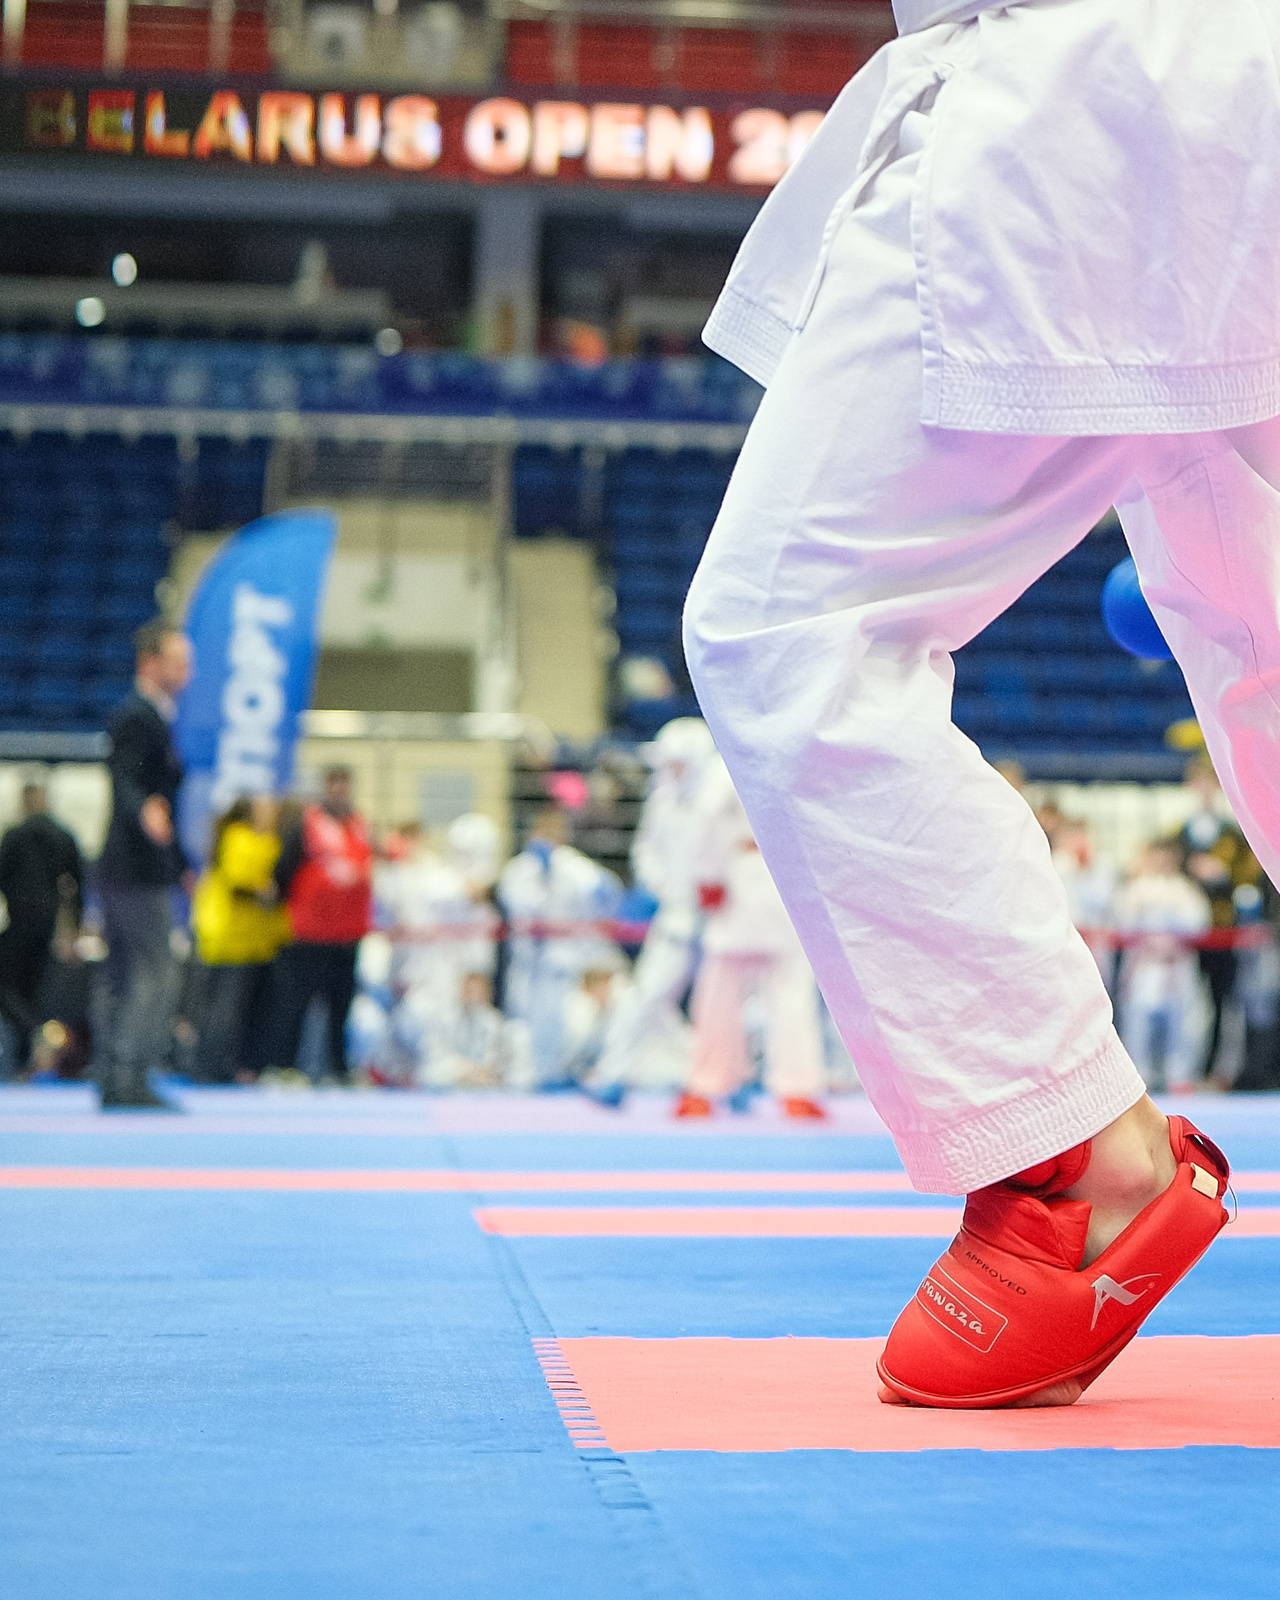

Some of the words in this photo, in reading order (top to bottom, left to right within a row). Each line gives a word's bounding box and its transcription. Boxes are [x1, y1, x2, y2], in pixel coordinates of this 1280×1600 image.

[26, 89, 443, 169] BELARUS
[464, 97, 714, 183] OPEN
[965, 1251, 1027, 1295] APPROVED
[921, 1280, 986, 1335] rawaza
